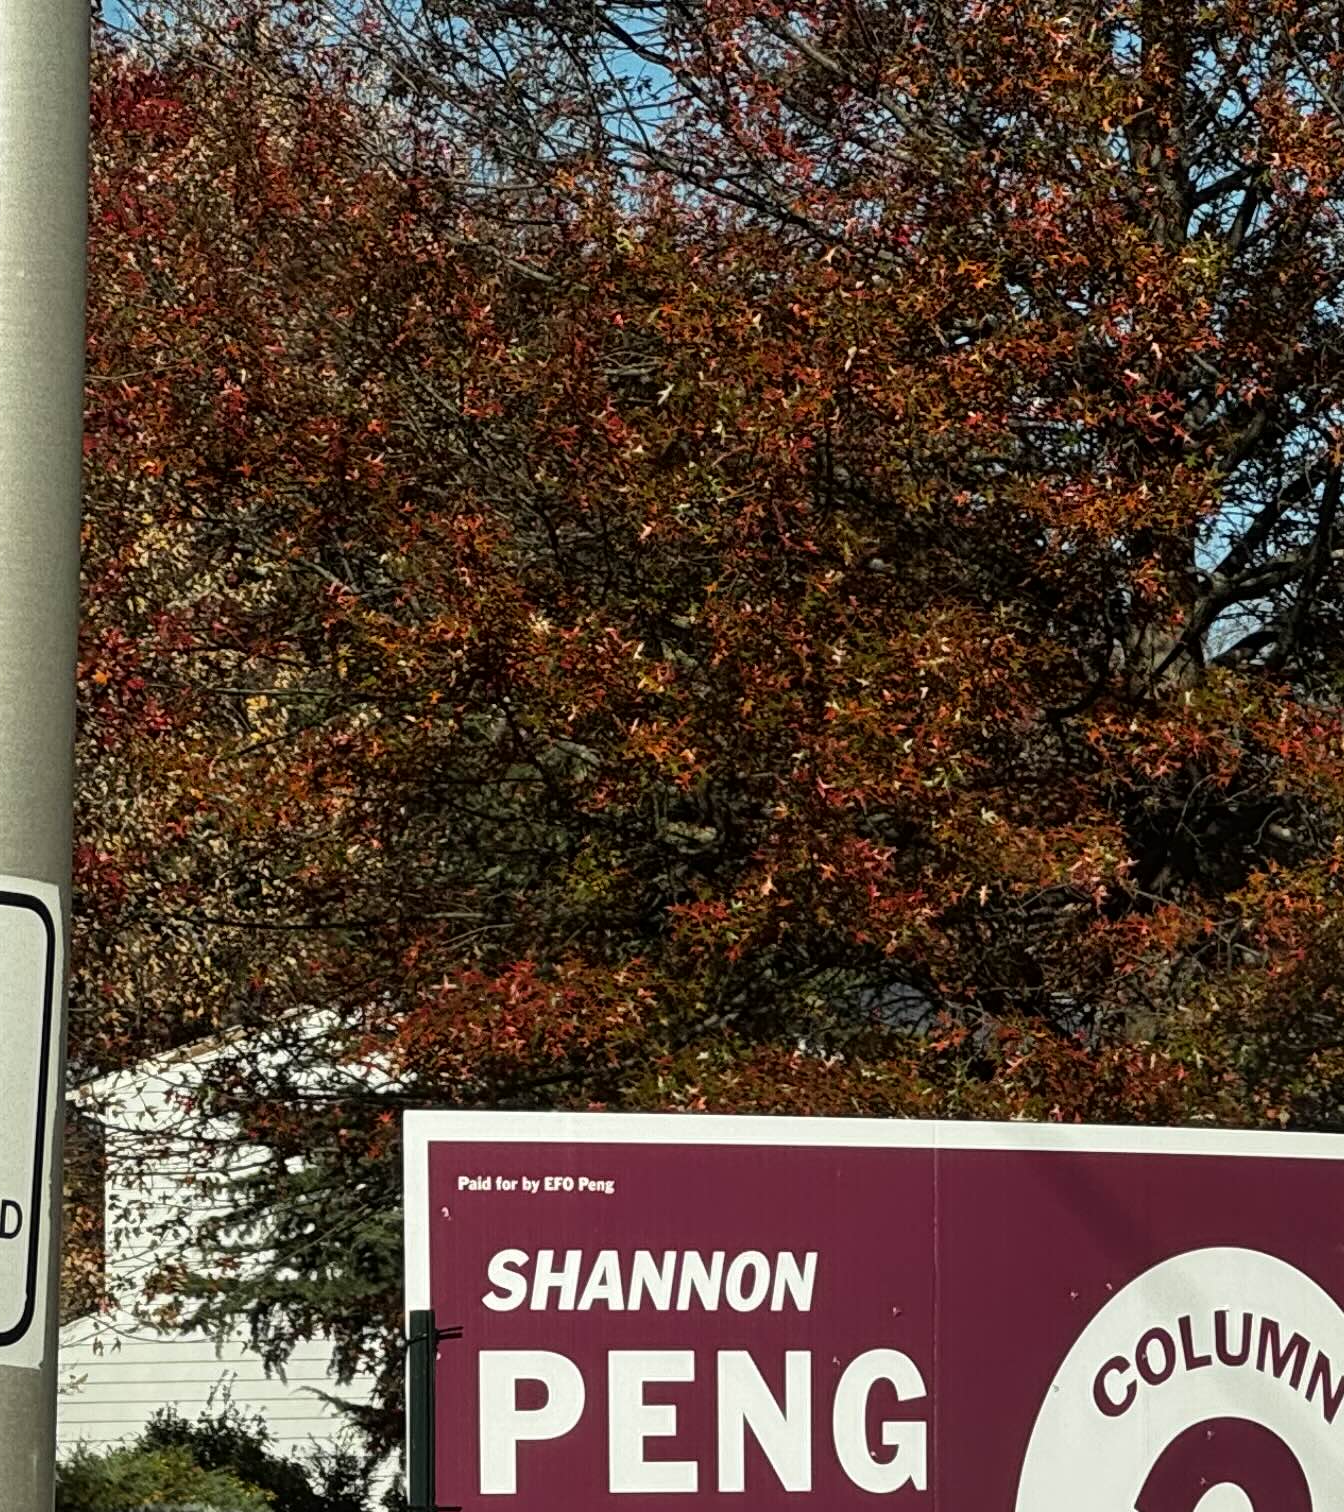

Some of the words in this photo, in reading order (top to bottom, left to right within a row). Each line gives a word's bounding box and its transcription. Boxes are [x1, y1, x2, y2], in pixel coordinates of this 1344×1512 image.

[457, 1175, 492, 1191] Paid
[495, 1175, 519, 1191] for
[521, 1175, 542, 1194] by
[543, 1176, 575, 1192] EFO
[578, 1176, 616, 1195] Peng
[481, 1248, 818, 1312] SHANNON
[478, 1348, 928, 1495] PENG
